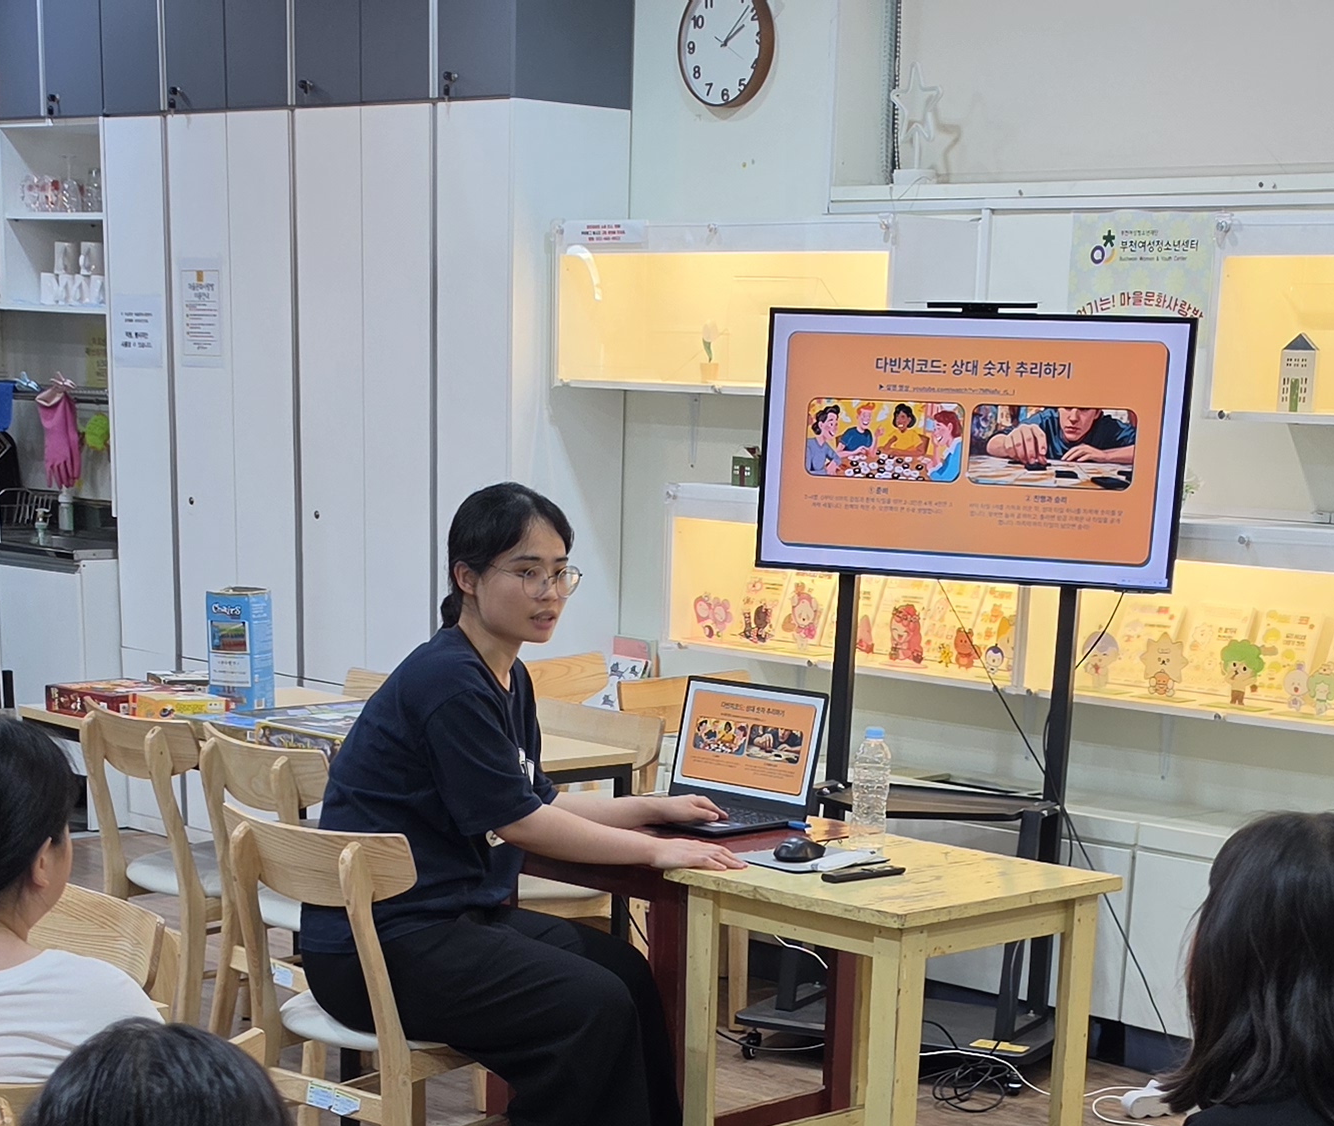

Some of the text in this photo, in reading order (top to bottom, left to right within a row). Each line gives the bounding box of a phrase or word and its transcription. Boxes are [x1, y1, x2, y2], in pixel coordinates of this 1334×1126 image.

[691, 15, 704, 29] 10
[688, 41, 695, 54] 9
[693, 65, 701, 79] 8
[705, 83, 713, 96] 7
[721, 88, 729, 101] 6
[1120, 240, 1199, 252] 부천여성청소년센터
[876, 357, 1072, 379] 다빈치코드: 상대 숫자 추리하기
[212, 603, 241, 614] Chairs
